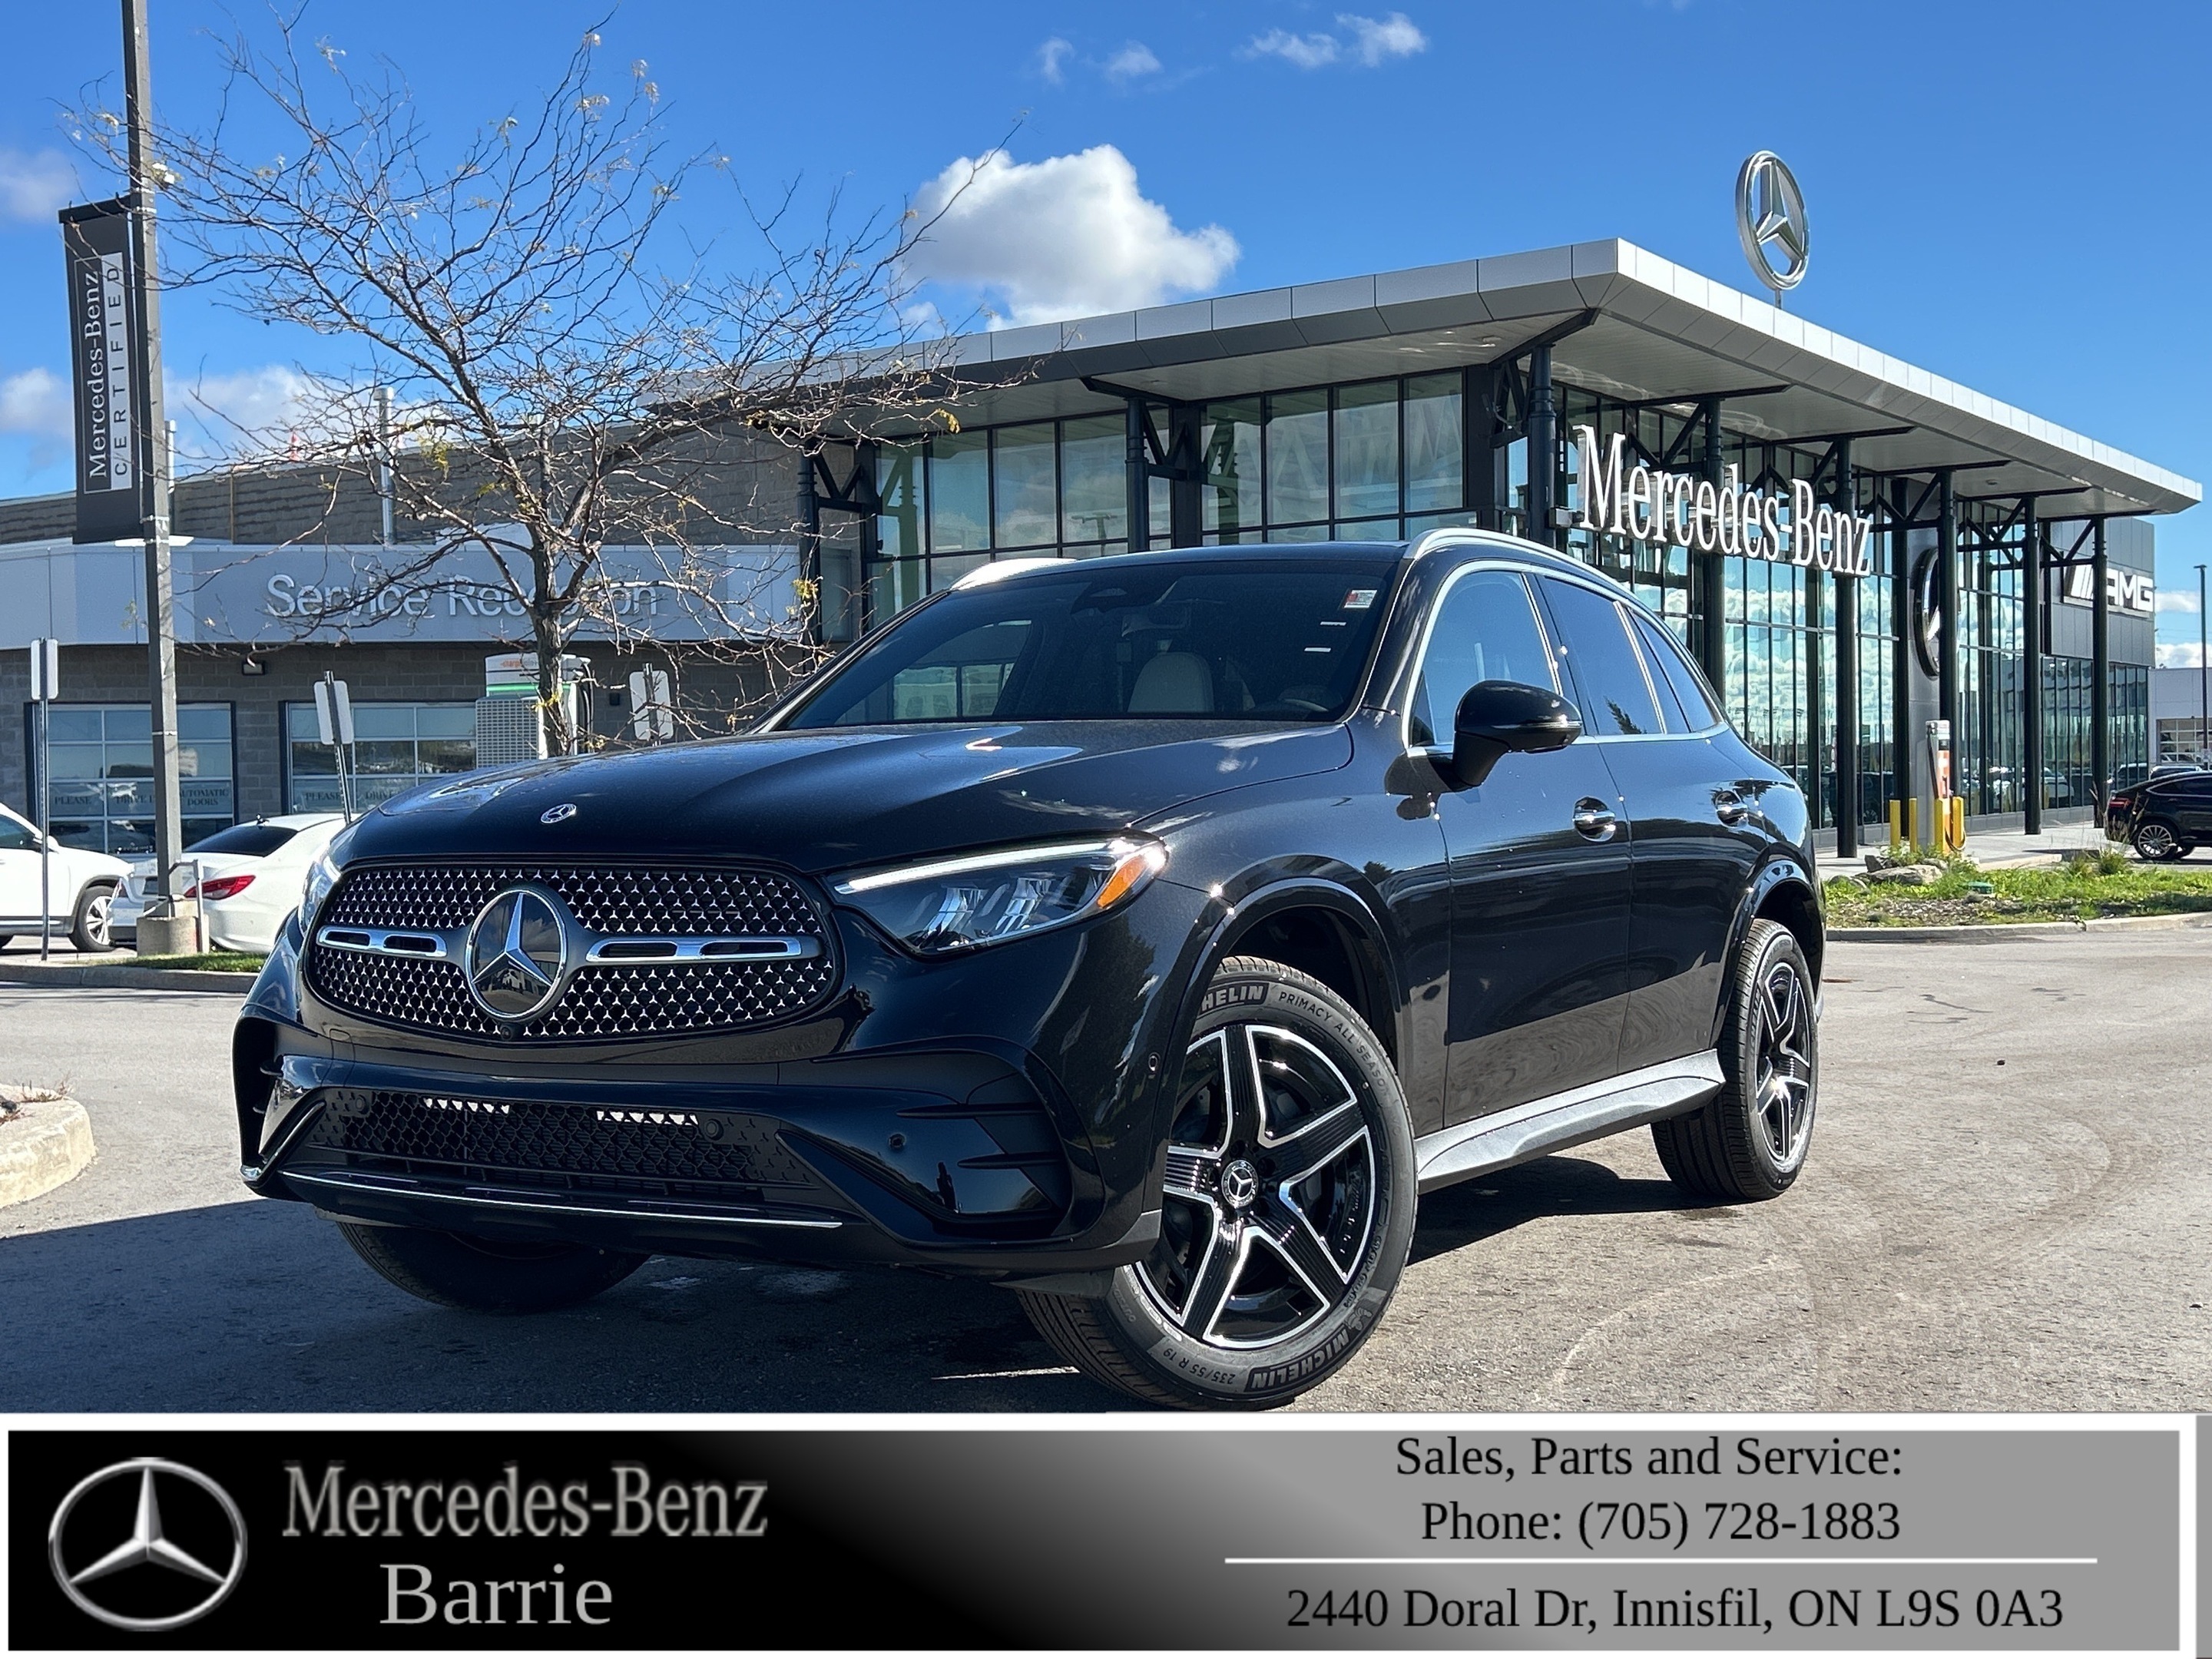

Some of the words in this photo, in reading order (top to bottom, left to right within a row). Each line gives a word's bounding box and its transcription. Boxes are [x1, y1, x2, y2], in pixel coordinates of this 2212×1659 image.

[84, 271, 107, 478] Mercedes-Benz
[106, 267, 127, 475] CERTIFIED
[1572, 424, 1872, 578] Mercedes-Benz
[267, 574, 430, 618] Service
[55, 796, 92, 805] PLEASE
[180, 789, 229, 797] UTOMATIC
[1201, 985, 1264, 1012] HELIN
[1278, 992, 1333, 1021] PRIMACY
[1334, 1019, 1354, 1043] ALL
[1163, 1348, 1177, 1363] 19
[1178, 1357, 1188, 1369] R
[1250, 1328, 1351, 1388] MICHELIN
[1189, 1366, 1237, 1385] 235/55
